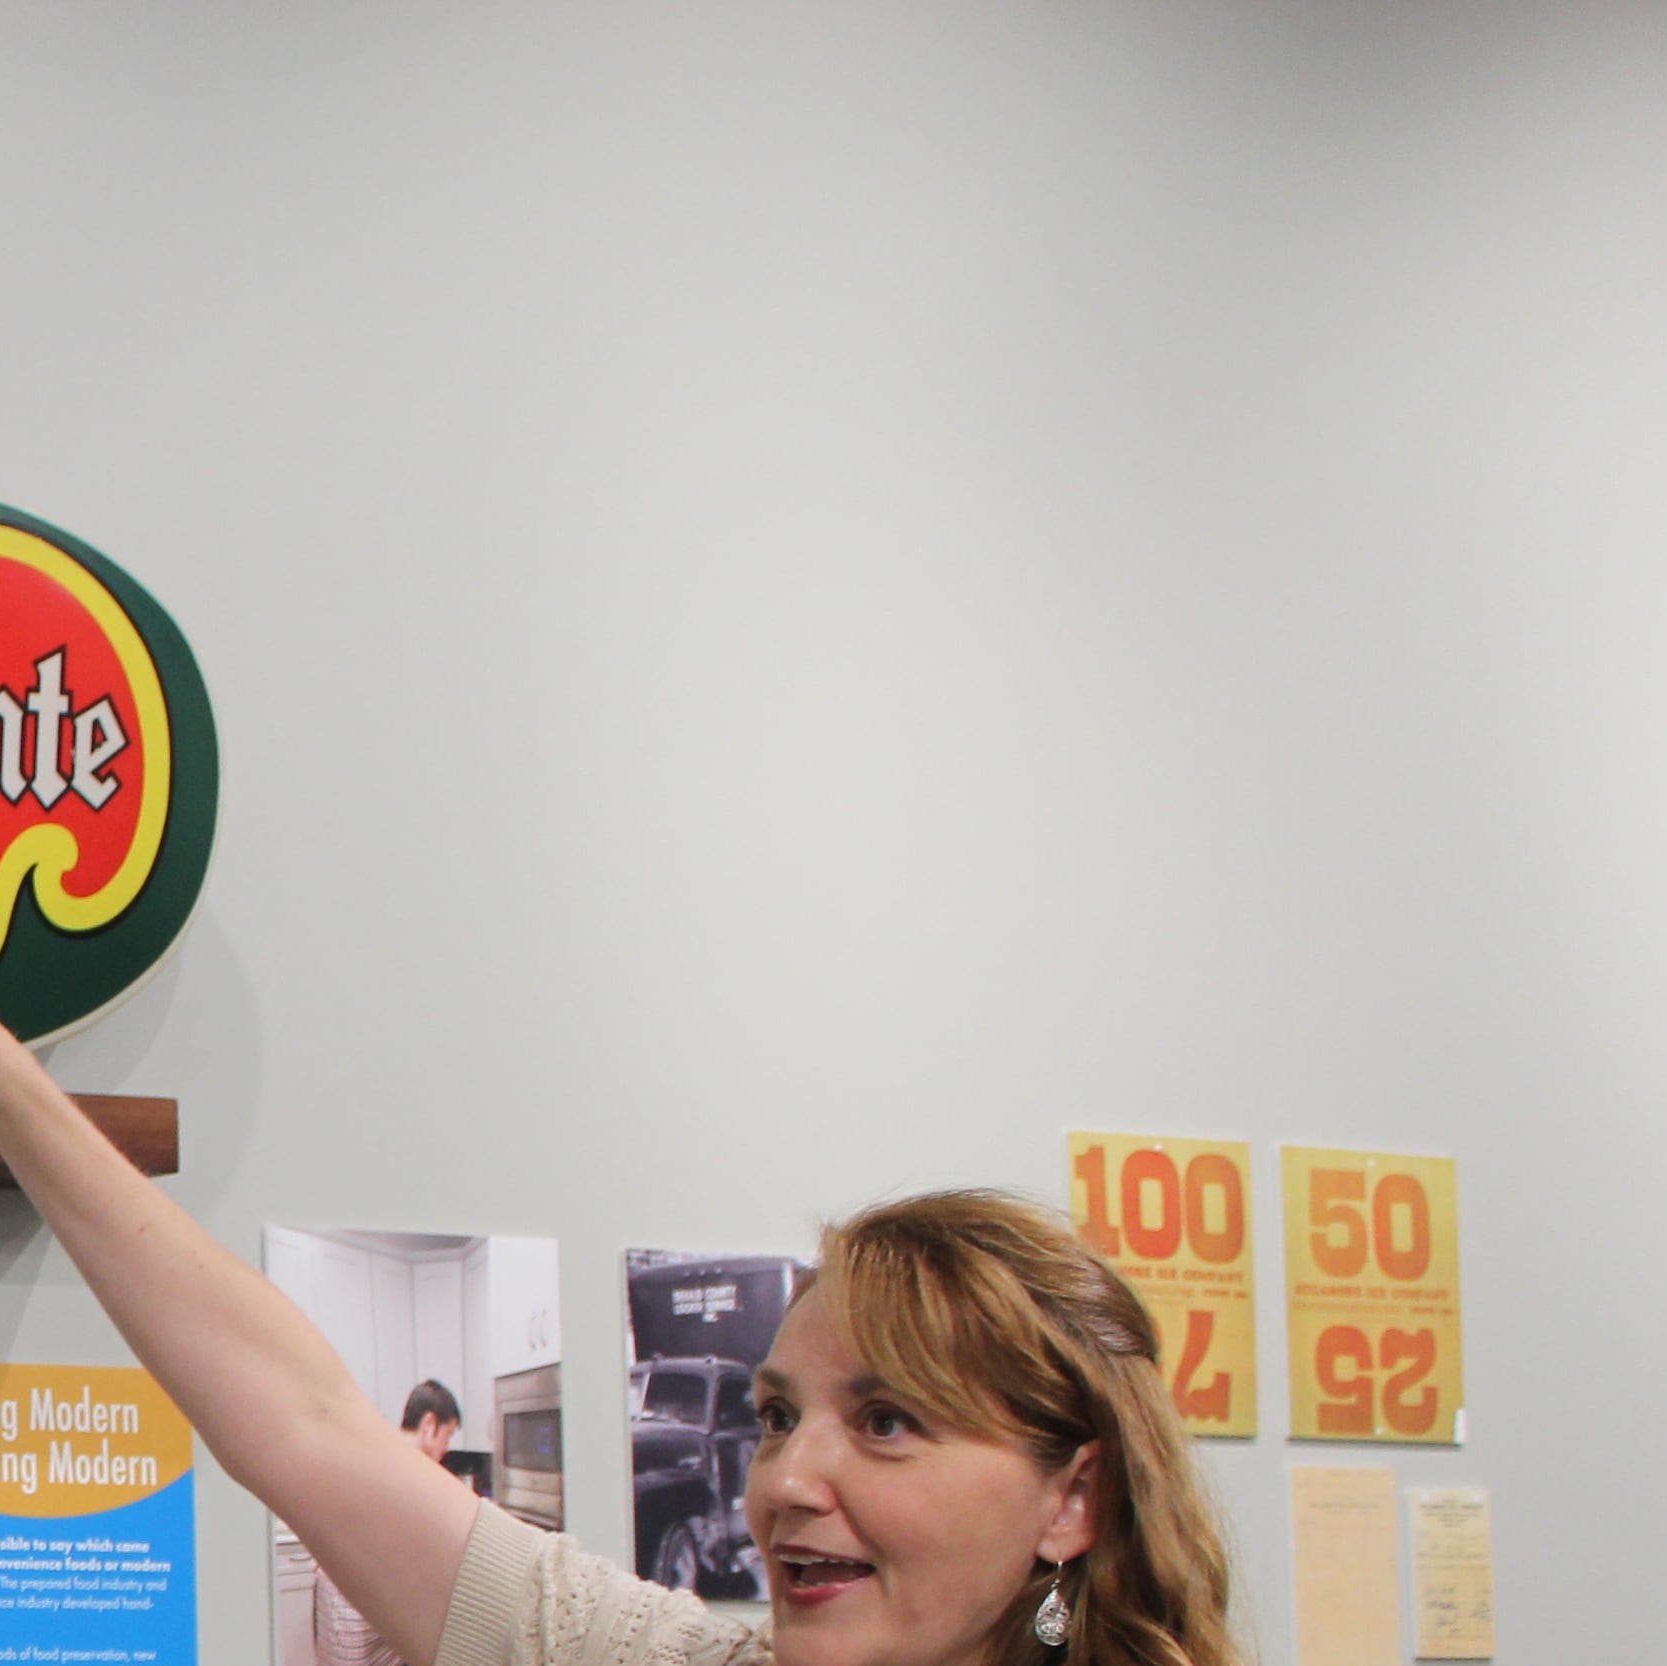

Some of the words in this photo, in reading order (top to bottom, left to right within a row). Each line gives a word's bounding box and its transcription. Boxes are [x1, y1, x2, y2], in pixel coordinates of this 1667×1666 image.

[1075, 1146, 1245, 1266] 100
[1308, 1168, 1431, 1282] 50
[30, 1385, 139, 1434] Modern
[48, 1438, 158, 1486] Modern
[33, 1538, 46, 1552] to
[49, 1540, 72, 1555] say
[76, 1538, 113, 1552] which
[116, 1542, 149, 1553] came
[65, 1557, 101, 1571] foods
[105, 1561, 118, 1571] or
[121, 1559, 170, 1572] modern
[0, 1576, 17, 1588] The
[21, 1578, 71, 1591] prepared
[74, 1577, 99, 1590] food
[102, 1578, 142, 1592] industry
[147, 1579, 167, 1591] and
[17, 1597, 59, 1611] industry
[63, 1597, 119, 1611] developed
[123, 1597, 153, 1610] hand-
